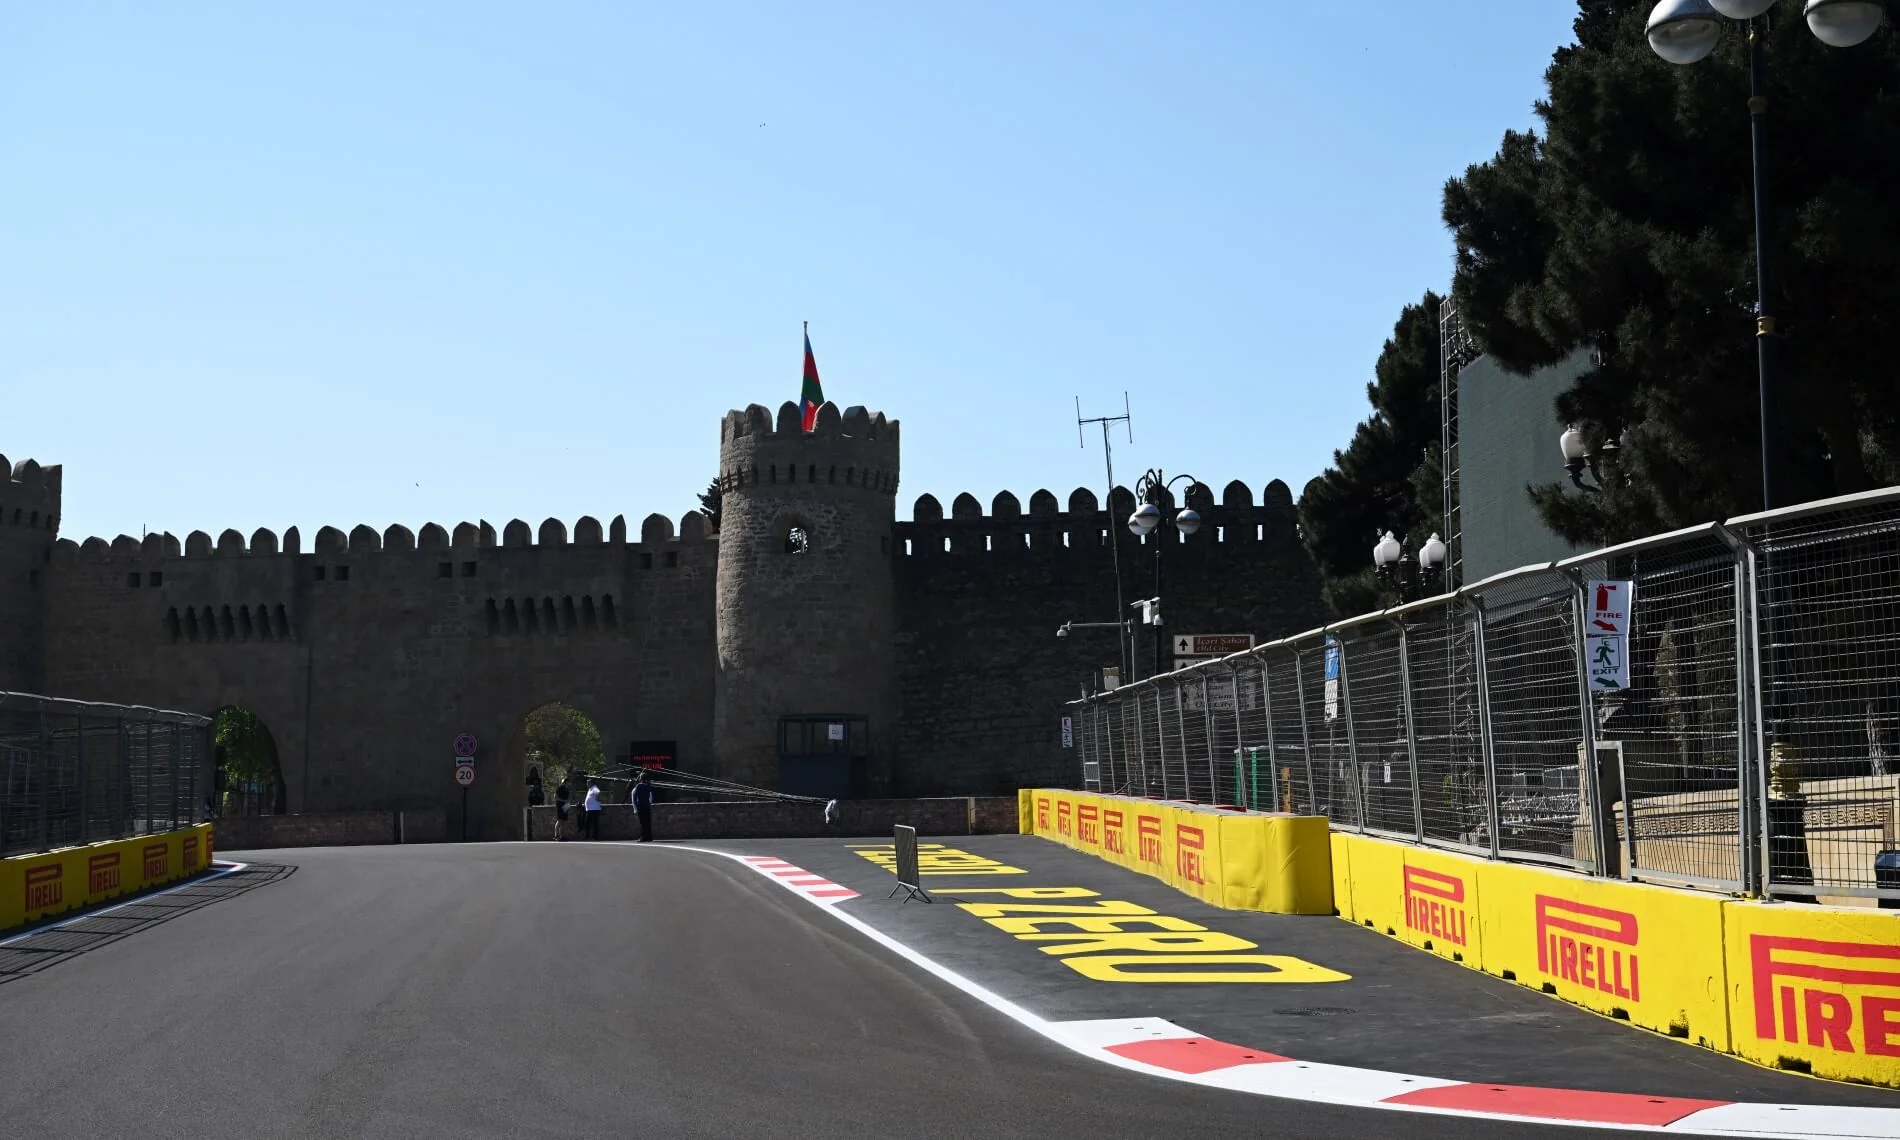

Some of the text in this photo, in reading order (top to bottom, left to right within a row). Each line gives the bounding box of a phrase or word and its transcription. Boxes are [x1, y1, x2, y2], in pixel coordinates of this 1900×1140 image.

[1592, 668, 1619, 676] EXIT
[459, 770, 472, 780] 20
[25, 864, 62, 913] PIRELLI
[88, 852, 120, 896] PIRELLI
[1403, 864, 1467, 947] PIRELLI
[1535, 894, 1640, 1002] PIRELLI
